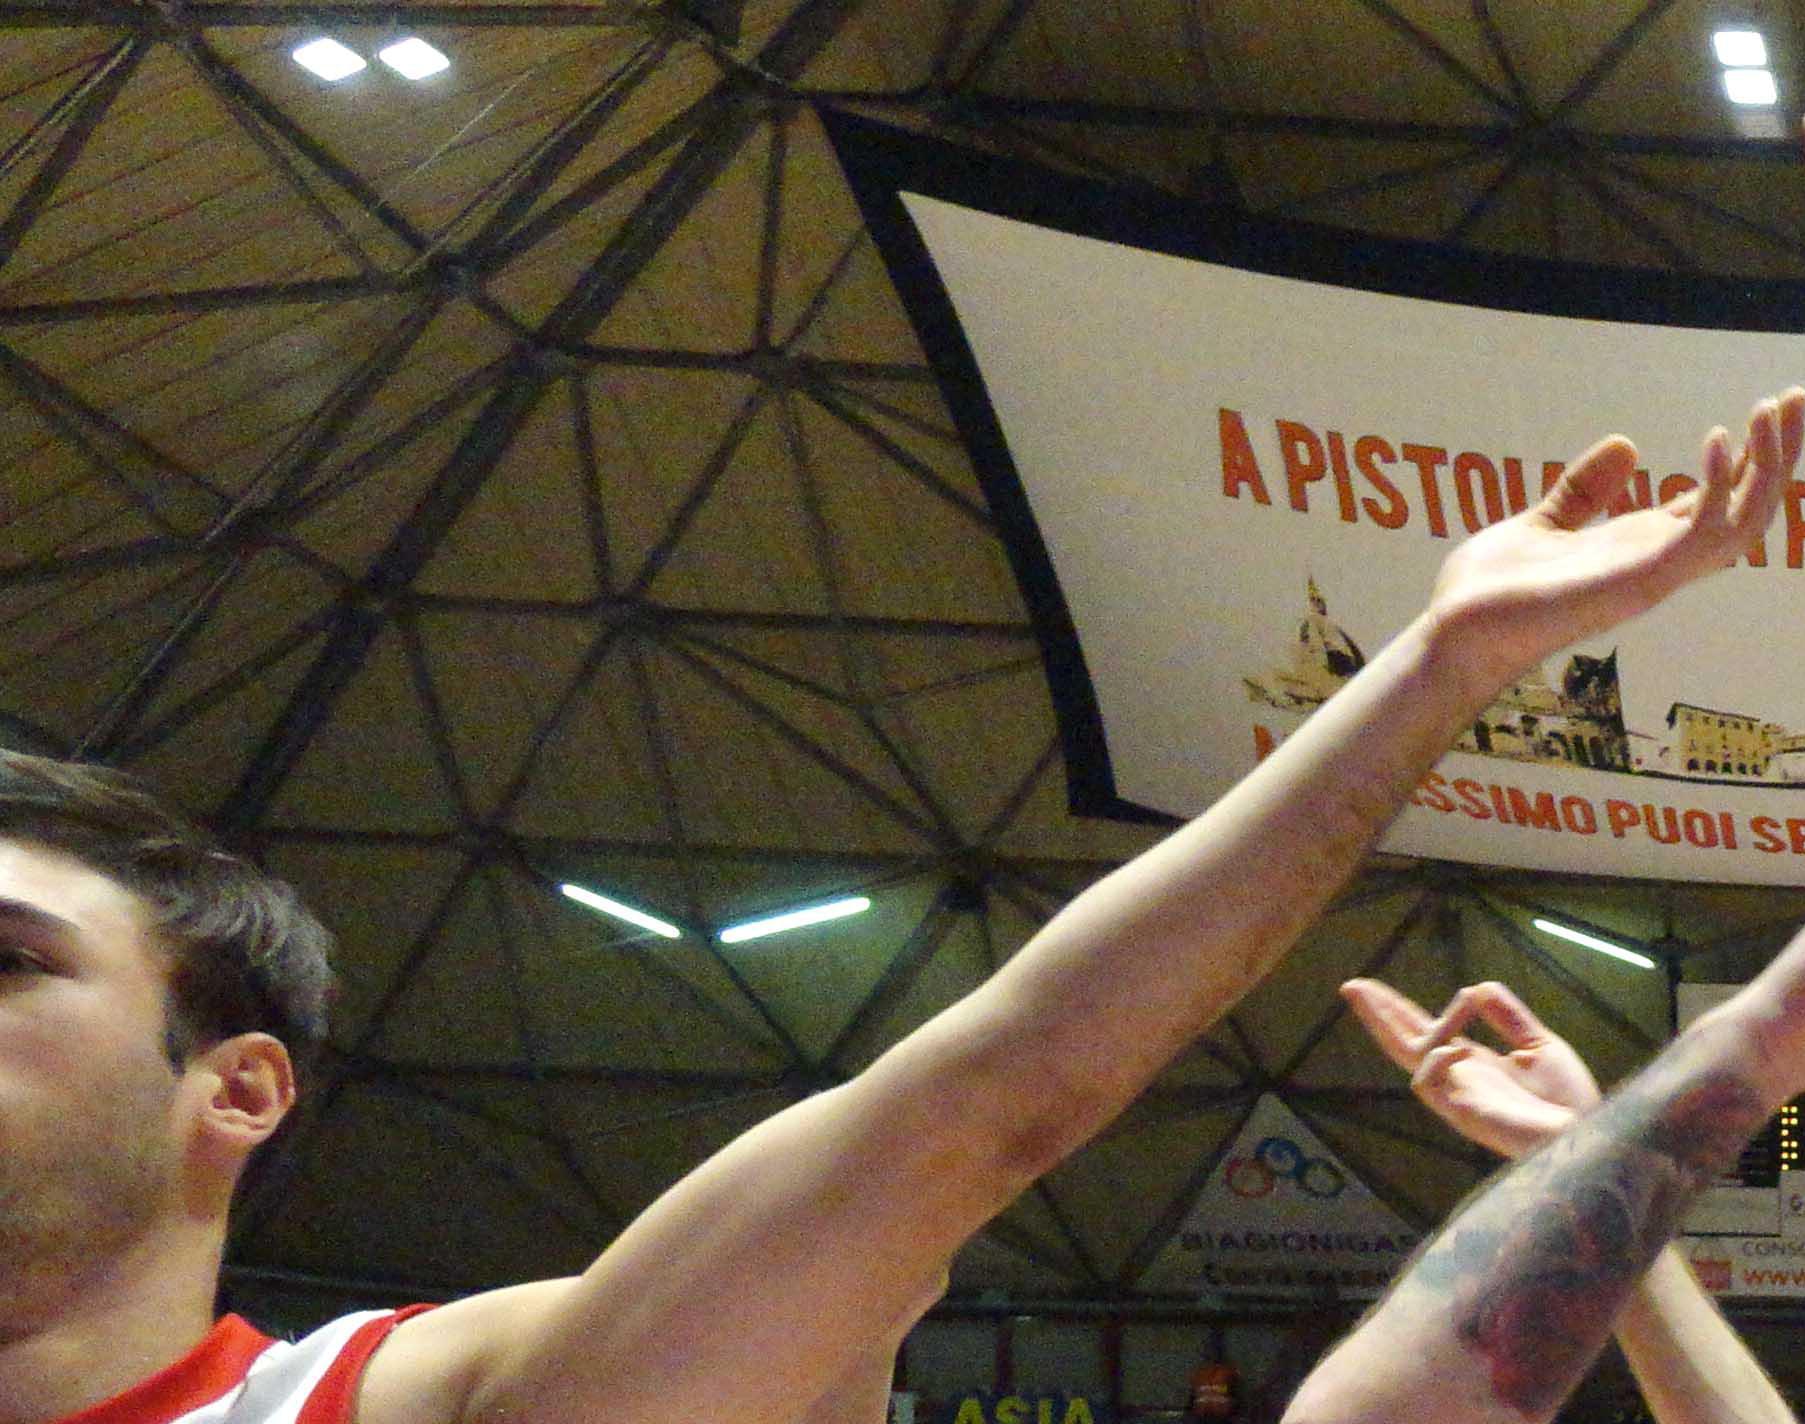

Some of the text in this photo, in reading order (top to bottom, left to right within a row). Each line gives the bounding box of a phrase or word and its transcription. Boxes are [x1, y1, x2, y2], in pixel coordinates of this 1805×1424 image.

[1219, 407, 1273, 506] A
[1410, 772, 1598, 835] SSIMO
[1607, 798, 1738, 850] PUOI
